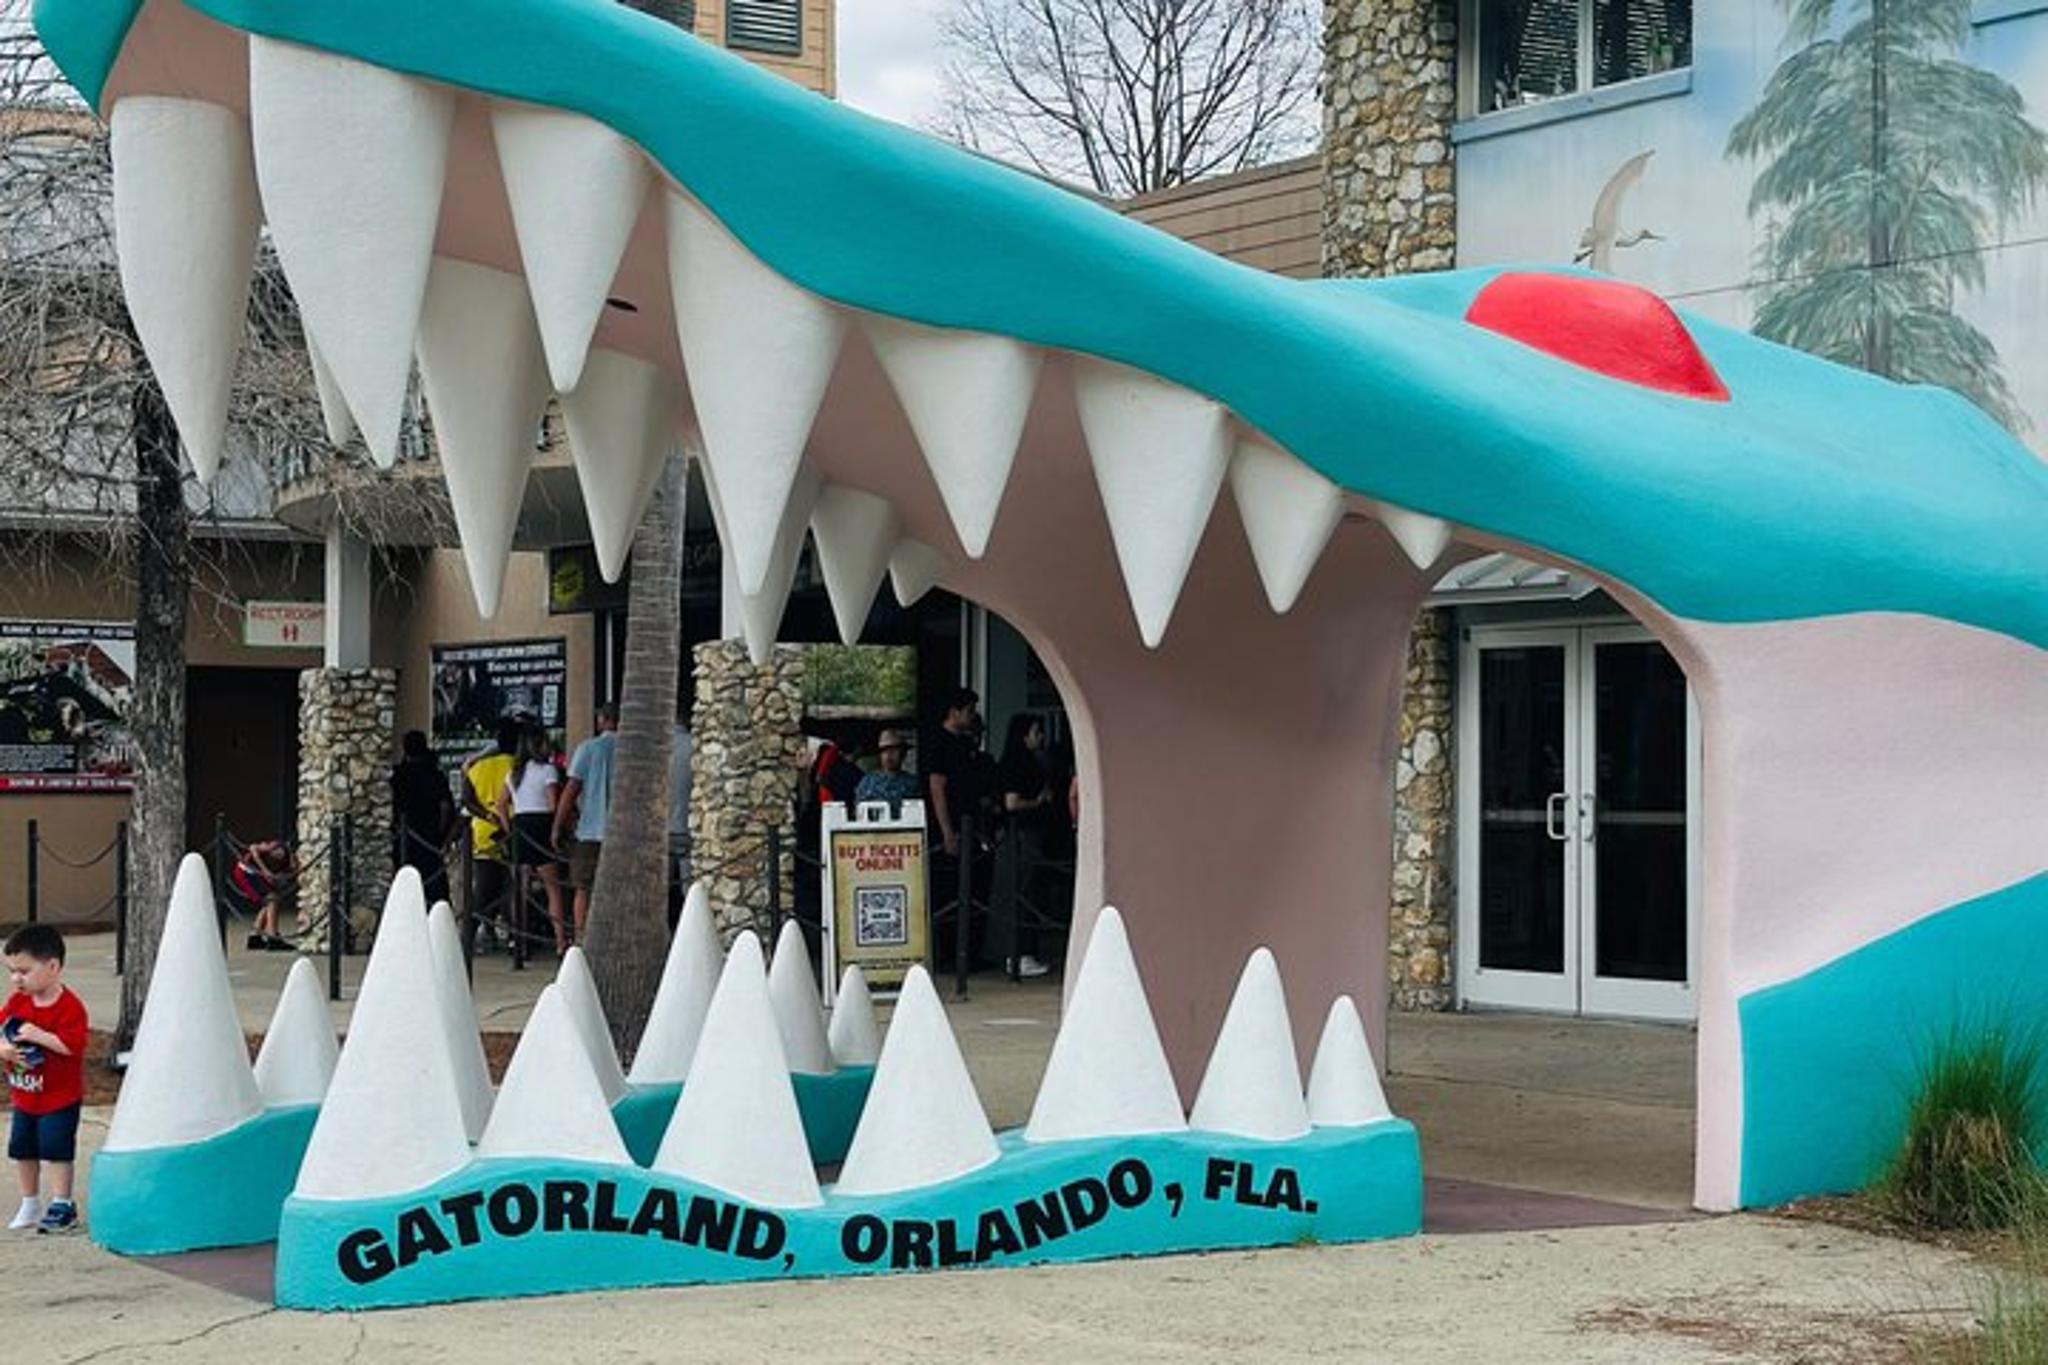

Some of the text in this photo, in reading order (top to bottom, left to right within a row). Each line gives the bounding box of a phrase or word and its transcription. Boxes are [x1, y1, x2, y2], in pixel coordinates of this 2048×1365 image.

[838, 844, 920, 859] BUY TICKETS
[855, 857, 904, 871] ONLINE
[337, 1180, 795, 1285] GATORLAND,
[1204, 1157, 1319, 1214] FLA.
